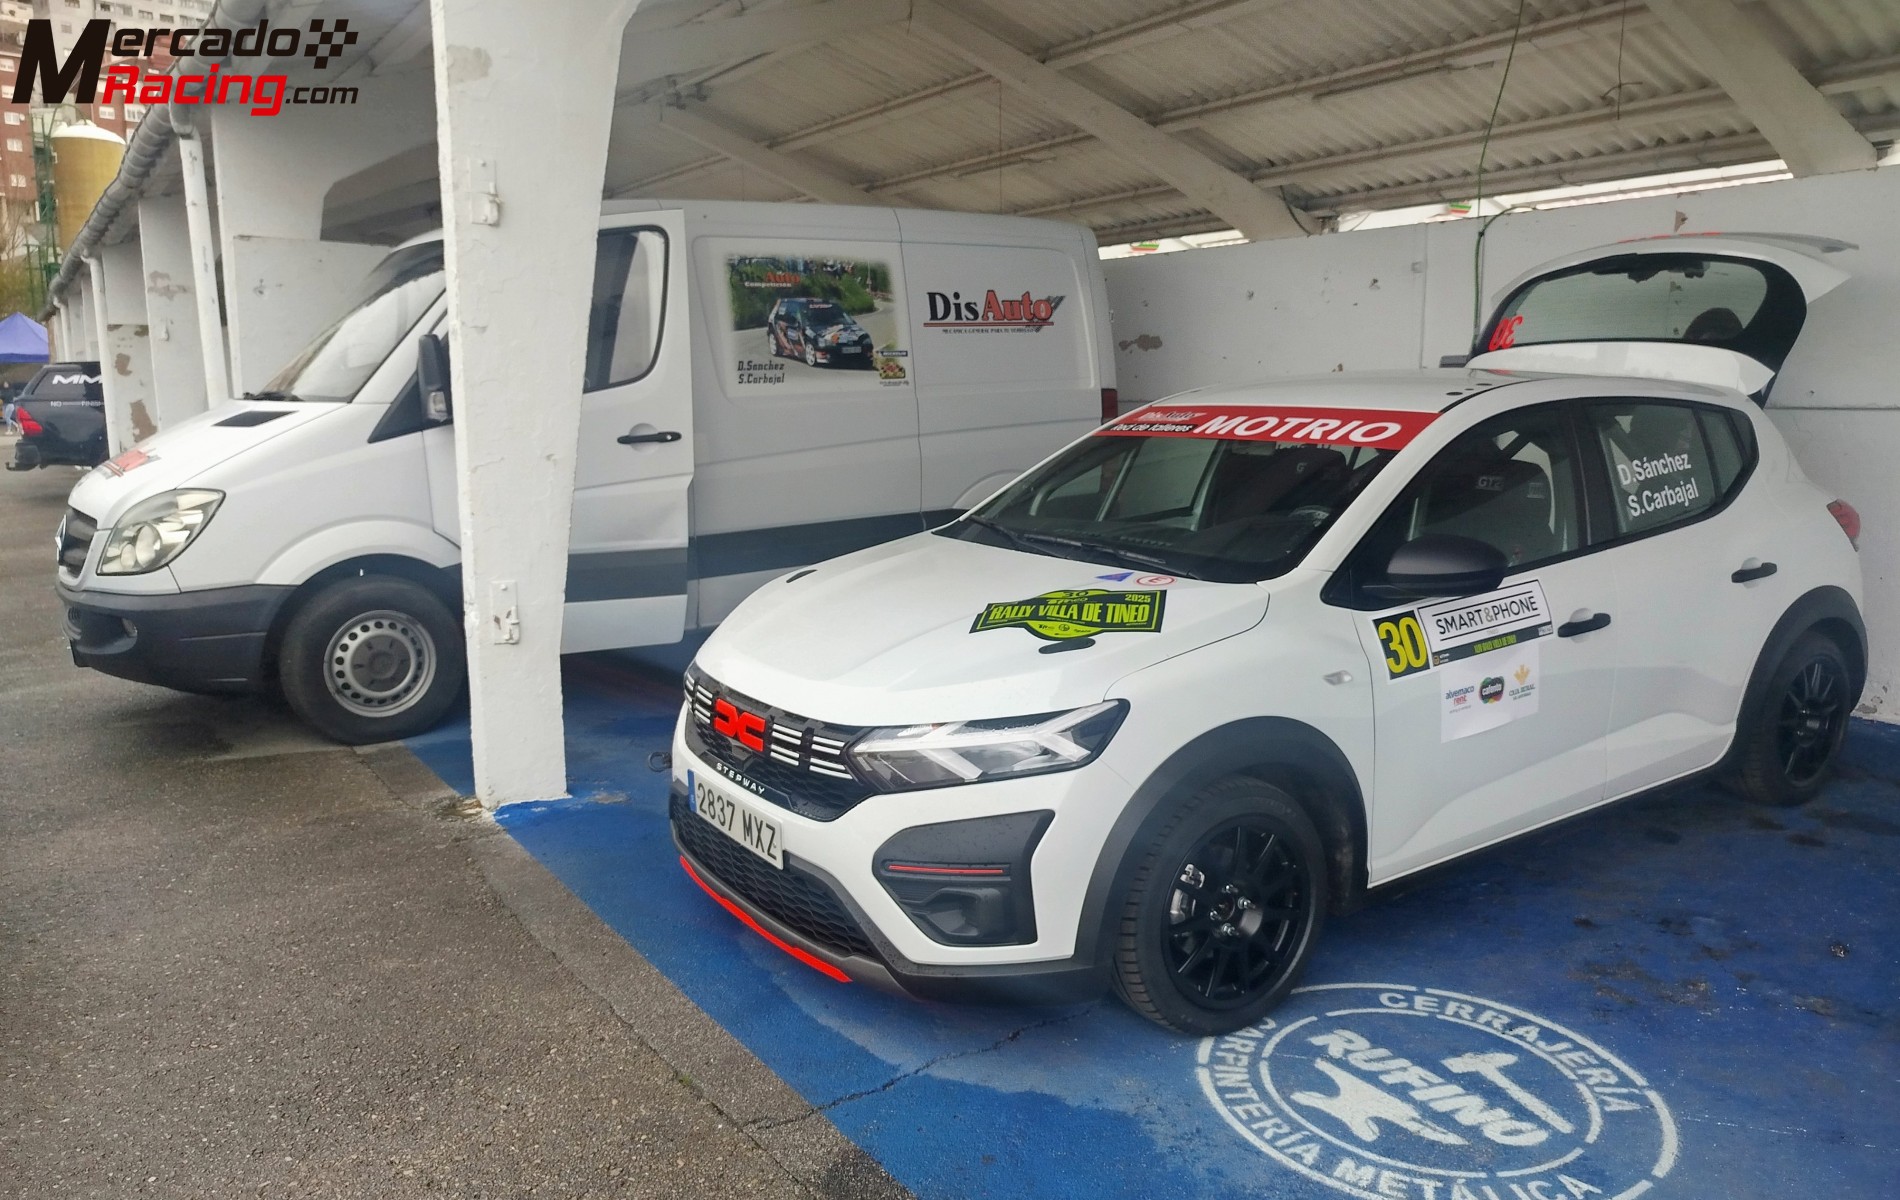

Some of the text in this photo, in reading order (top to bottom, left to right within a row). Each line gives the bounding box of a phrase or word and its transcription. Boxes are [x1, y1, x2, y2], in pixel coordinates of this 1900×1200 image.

[926, 290, 1053, 322] DisAuto
[1193, 415, 1402, 443] MOTRIO
[1617, 453, 1691, 485] D.Sánchez
[1628, 477, 1699, 517] S.Carbajal
[989, 604, 1036, 621] RALLY
[1038, 603, 1079, 620] VILLA
[1082, 603, 1103, 623] DE
[1105, 604, 1150, 624] TINEO
[1124, 593, 1151, 603] 2025
[1378, 616, 1428, 674] 30
[716, 762, 765, 794] STEPWAY
[698, 783, 777, 861] 2837 MXZ
[1308, 1029, 1549, 1146] RUFINO
